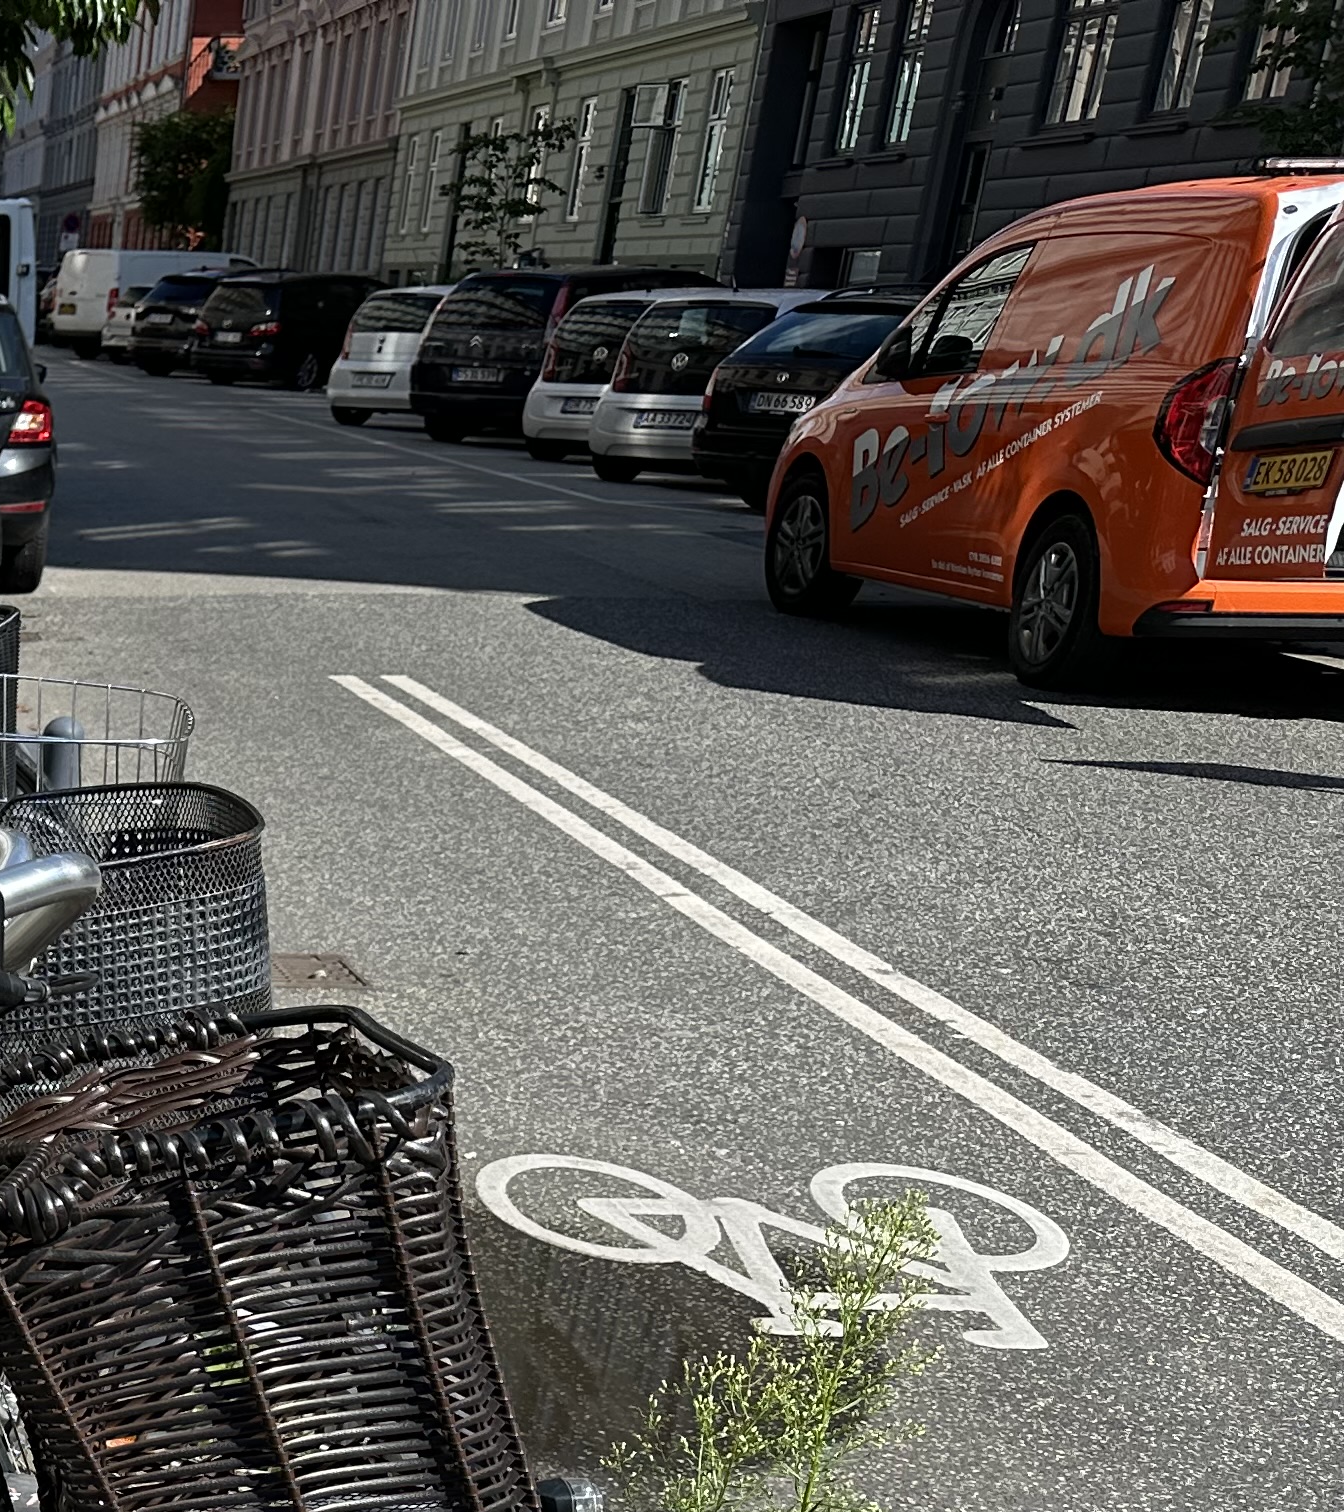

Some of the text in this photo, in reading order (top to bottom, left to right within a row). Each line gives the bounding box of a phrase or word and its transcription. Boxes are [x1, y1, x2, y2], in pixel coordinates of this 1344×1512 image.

[1005, 416, 1052, 459] CONTAINER
[1253, 455, 1328, 486] EK 58 028
[1241, 514, 1328, 537] SALG SERVICE
[1216, 544, 1325, 565] AF ALLE CONTAINER
